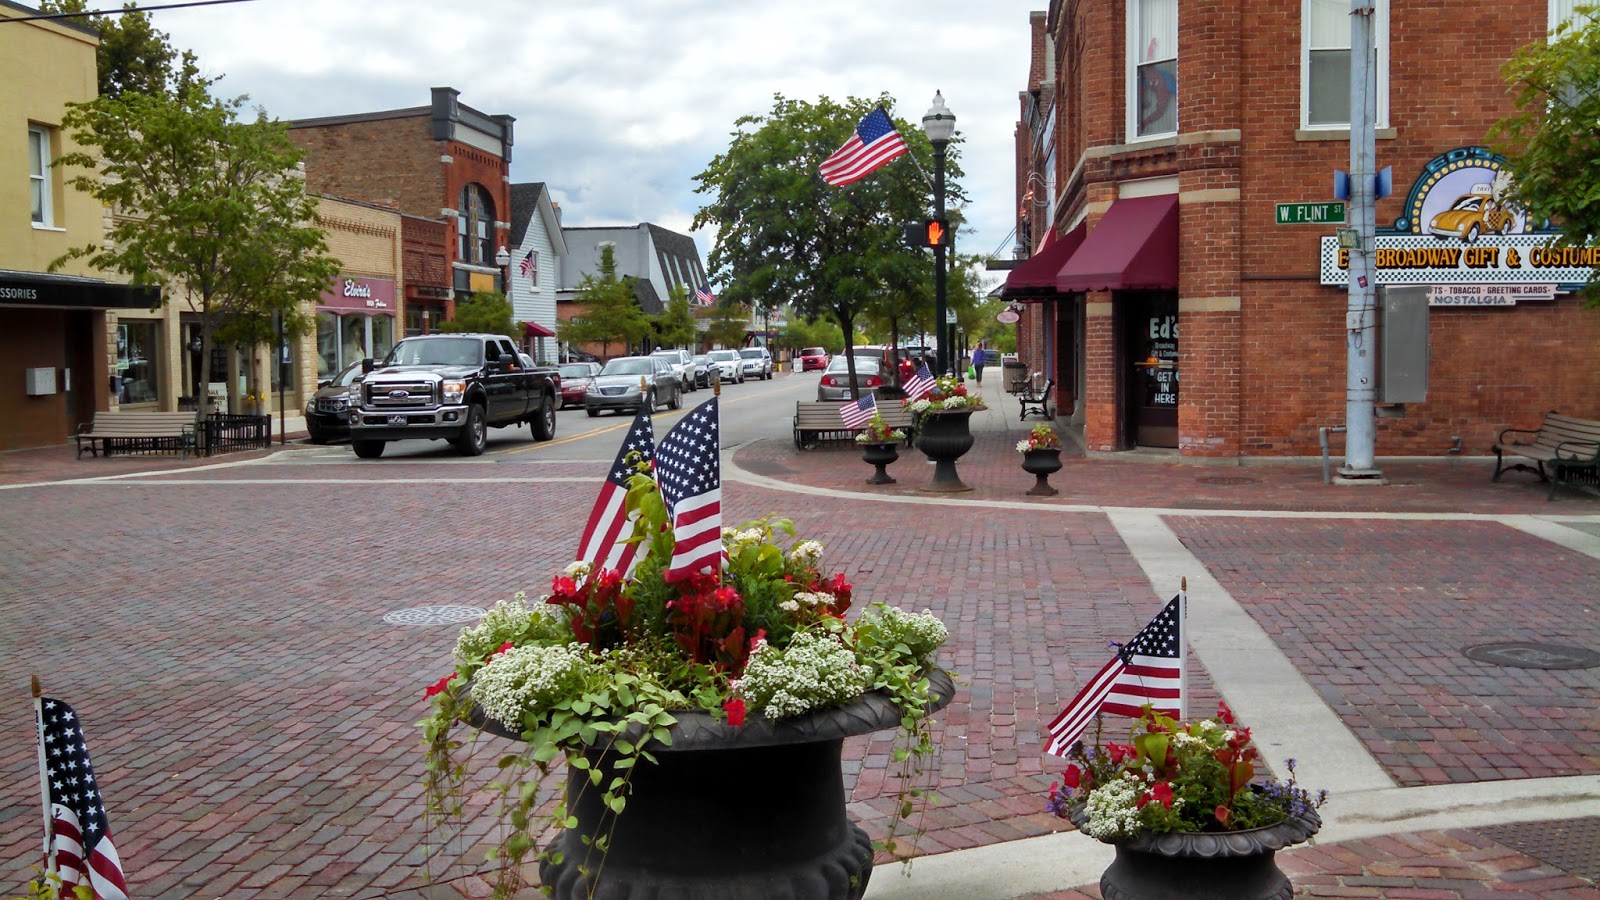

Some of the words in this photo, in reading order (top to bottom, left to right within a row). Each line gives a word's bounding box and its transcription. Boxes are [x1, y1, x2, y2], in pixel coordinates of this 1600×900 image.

[1280, 206, 1291, 221] W.
[1297, 205, 1328, 220] FLINT
[1334, 204, 1342, 213] ST
[1376, 248, 1461, 268] BROADWAY
[1463, 247, 1499, 268] GIFT
[1506, 247, 1521, 269] &
[0, 287, 37, 300] SSORIES
[1449, 286, 1481, 294] TOBACCO
[1487, 286, 1521, 294] GREETING
[1523, 286, 1548, 294] CARDS
[1434, 295, 1507, 304] NOSTALGIA
[1149, 315, 1178, 339] Ed's
[1157, 371, 1173, 382] GET
[1161, 383, 1169, 393] IN
[1154, 393, 1176, 404] HERE
